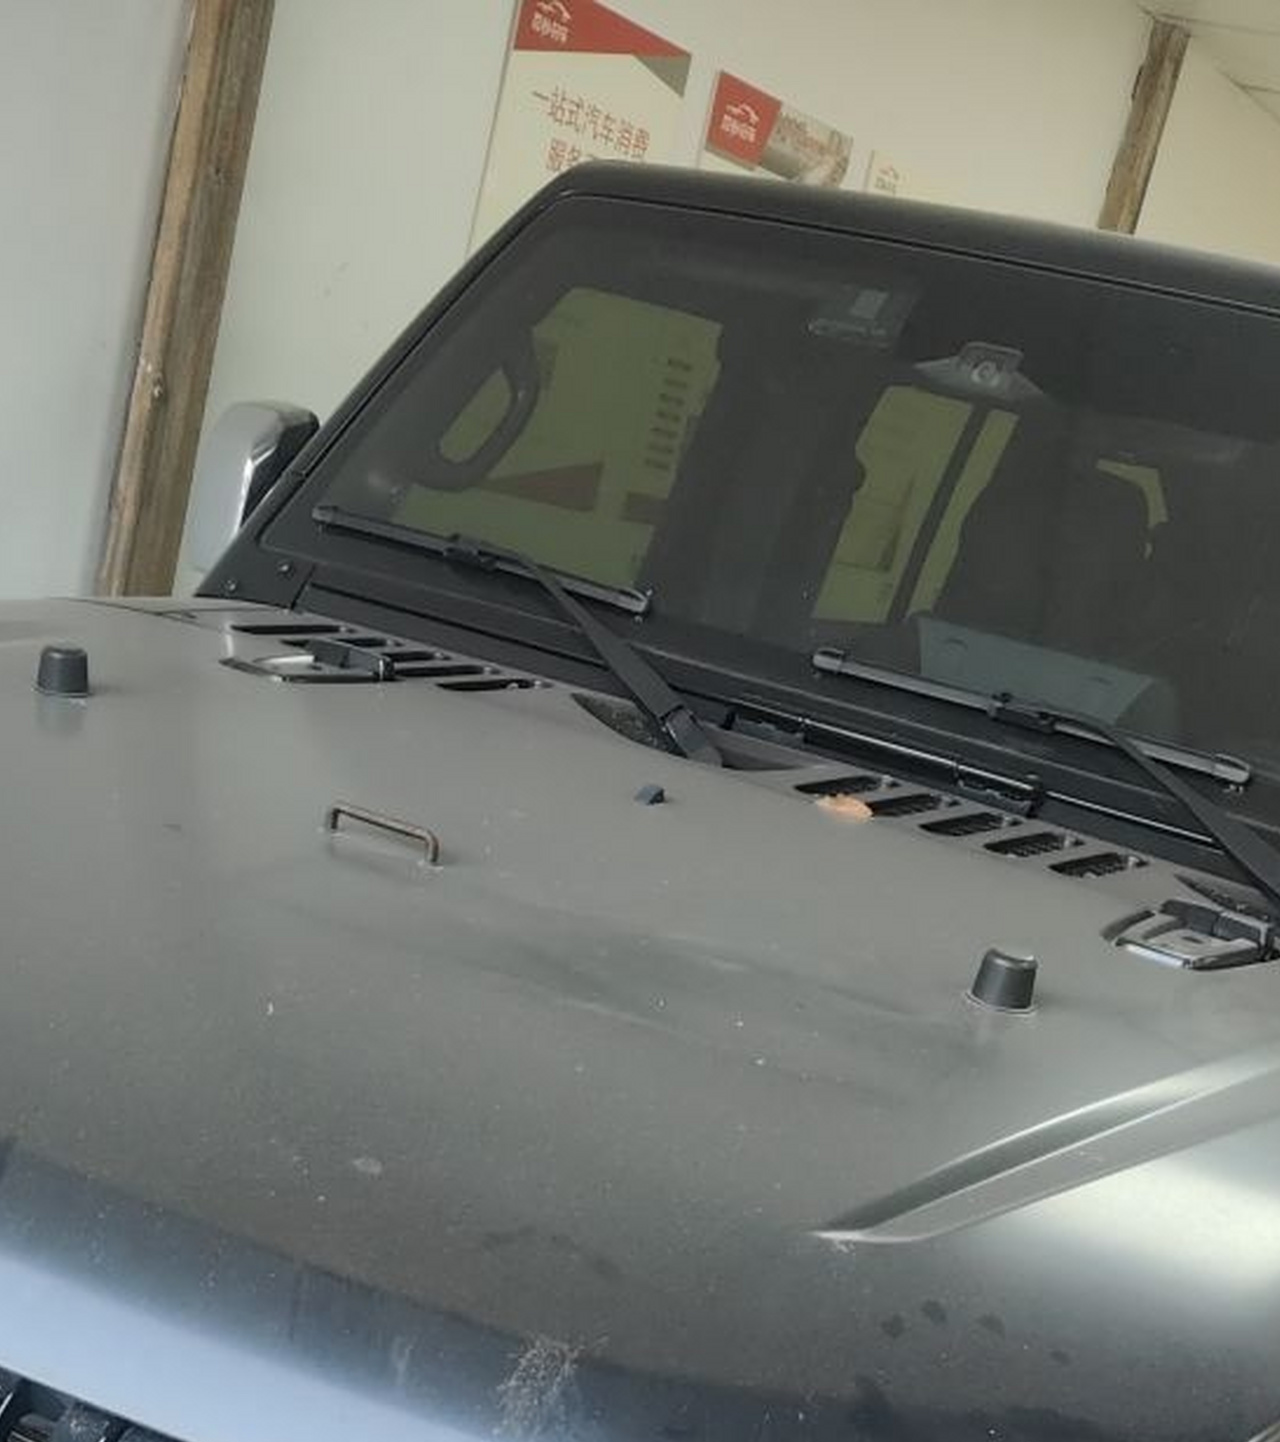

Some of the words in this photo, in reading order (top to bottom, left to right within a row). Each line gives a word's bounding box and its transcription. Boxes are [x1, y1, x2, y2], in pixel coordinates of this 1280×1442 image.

[531, 85, 650, 159] 一站式汽车消费
